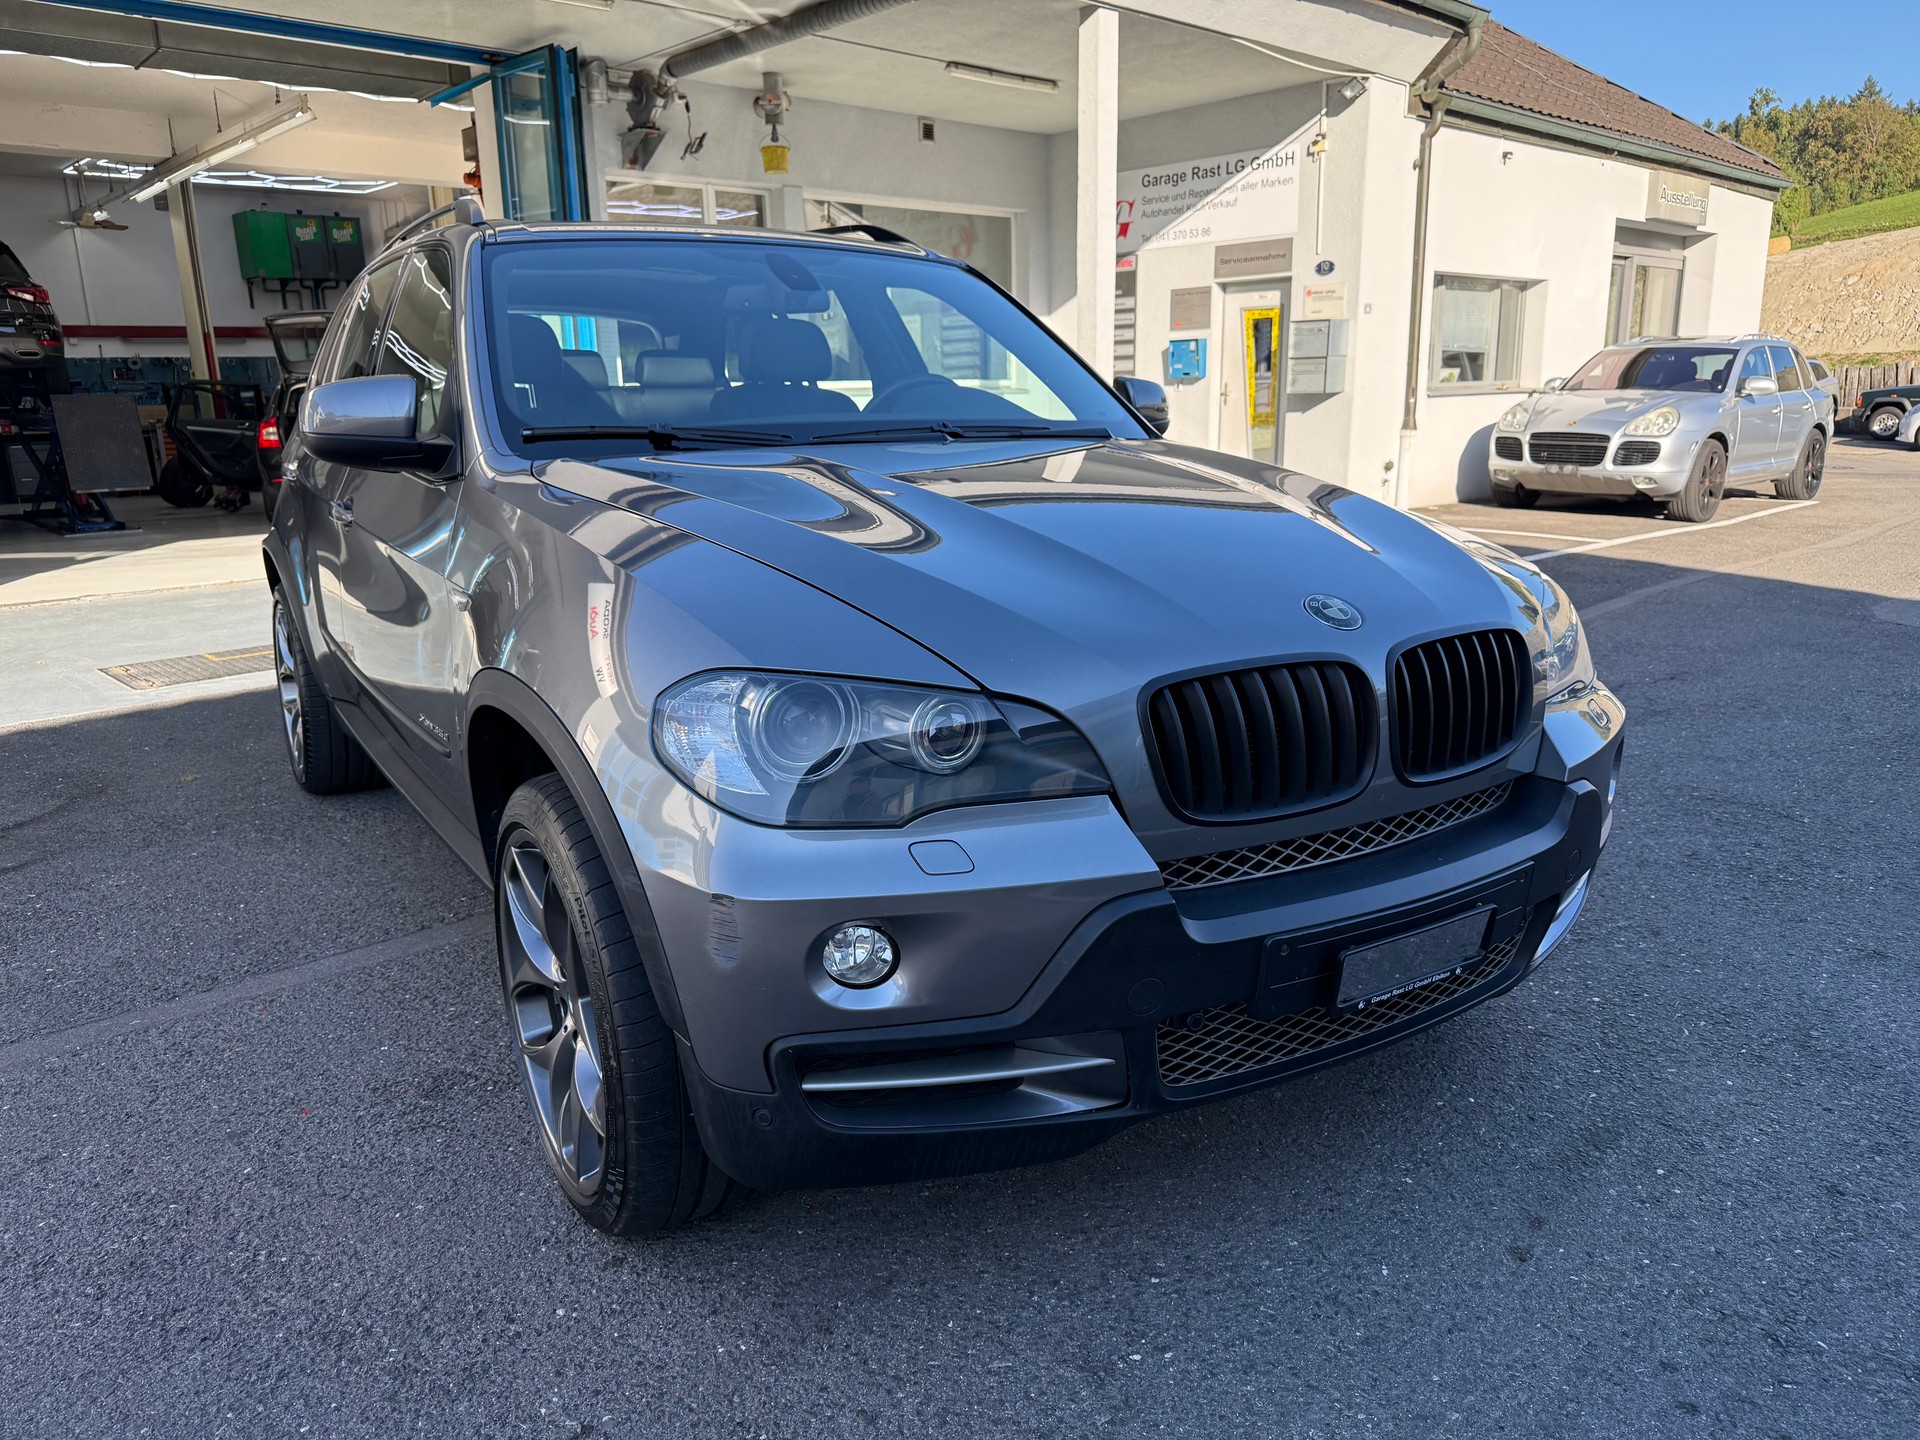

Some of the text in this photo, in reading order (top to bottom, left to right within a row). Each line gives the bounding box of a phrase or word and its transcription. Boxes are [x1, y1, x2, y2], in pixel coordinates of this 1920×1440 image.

[1141, 151, 1295, 188] Garage Rast LG GmbH
[1141, 195, 1170, 206] Service
[1171, 191, 1187, 202] und
[1240, 180, 1258, 192] aller
[1260, 176, 1294, 189] Marken
[1659, 185, 1707, 214] Ausstellung
[1141, 204, 1184, 219] Autohandel
[295, 226, 317, 237] QUAKER
[1219, 253, 1287, 266] Serviceannahme
[1371, 992, 1392, 1003] Garage
[1392, 987, 1405, 996] Rast
[1414, 976, 1432, 988] GmbH
